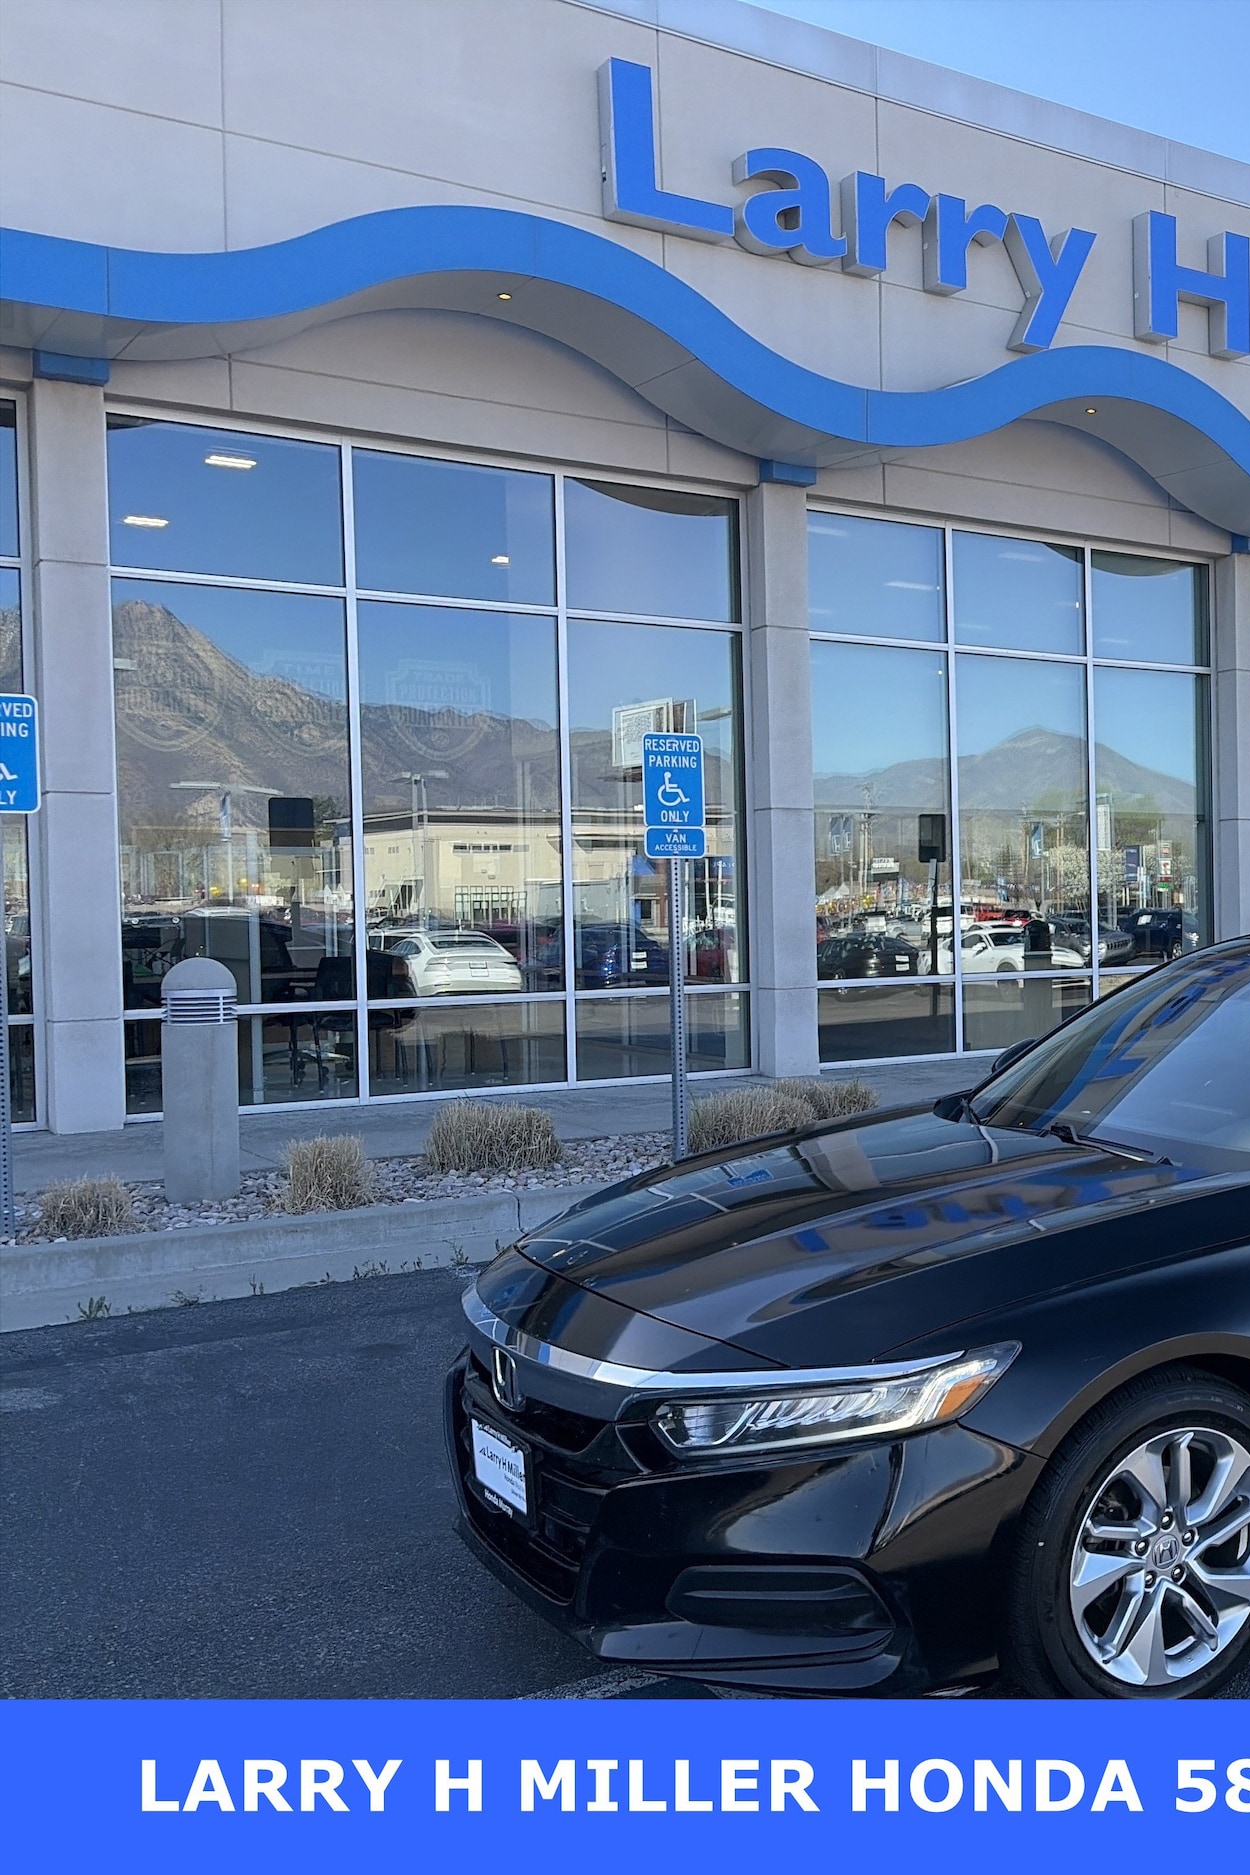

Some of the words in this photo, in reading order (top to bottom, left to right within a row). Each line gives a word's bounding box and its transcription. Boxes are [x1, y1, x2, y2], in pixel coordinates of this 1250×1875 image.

[597, 56, 1097, 353] Larry
[1132, 210, 1250, 361] H
[645, 738, 700, 752] RESERVED
[648, 756, 697, 768] PARKING
[660, 810, 690, 822] ONLY
[666, 833, 686, 844] VAN
[654, 844, 697, 852] ACCESSIBLE
[486, 1446, 502, 1470] Larry
[502, 1456, 507, 1471] H
